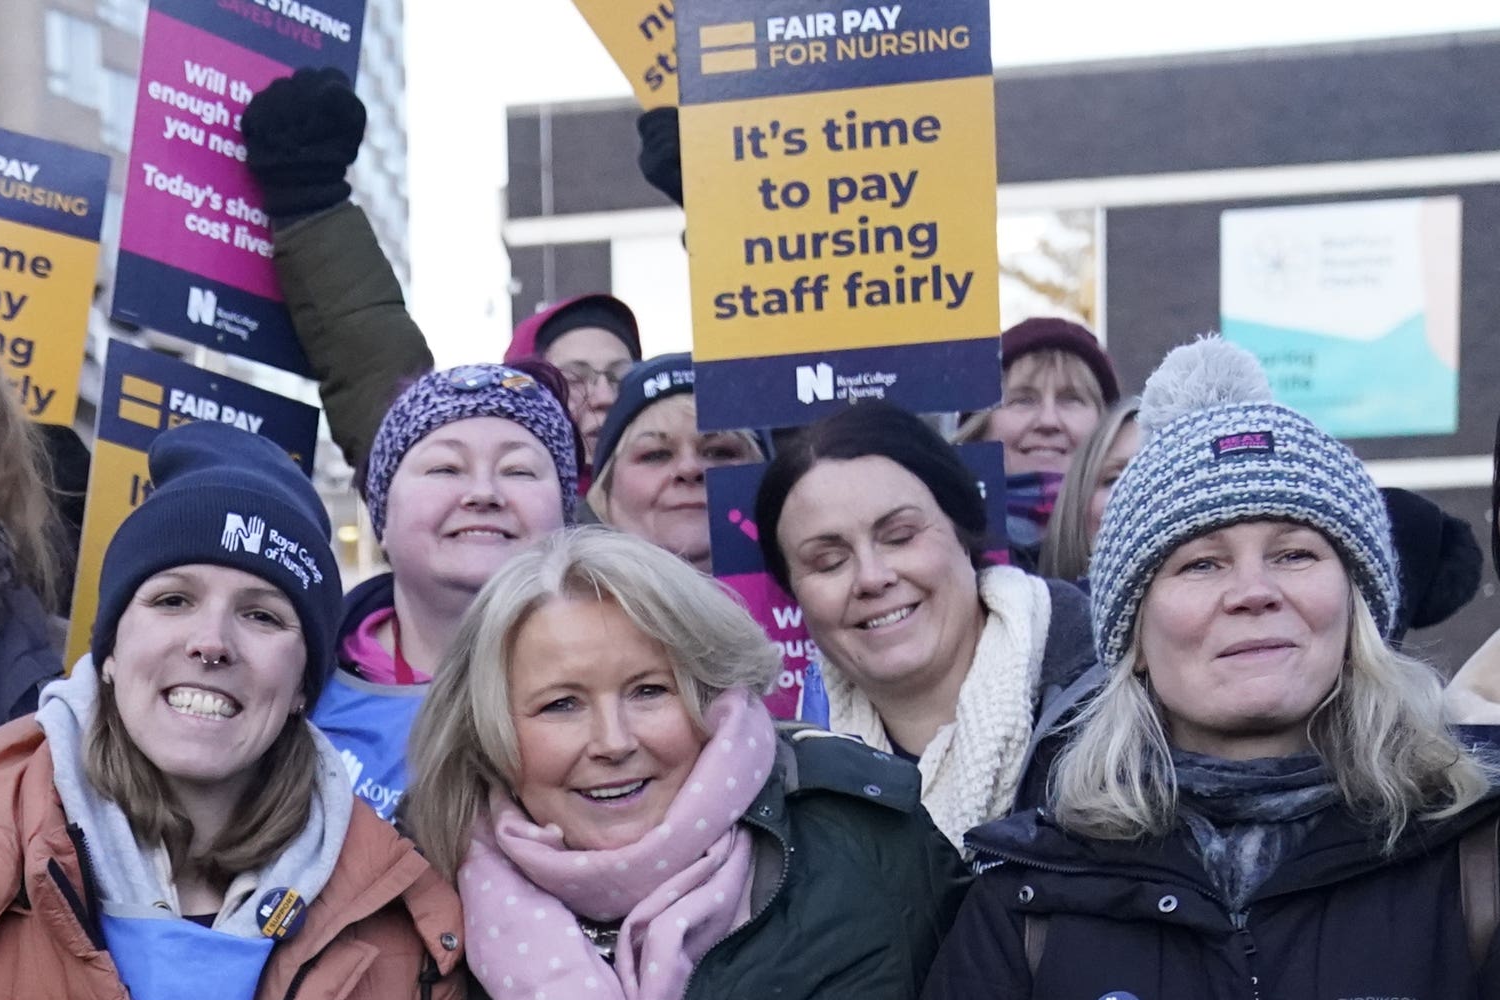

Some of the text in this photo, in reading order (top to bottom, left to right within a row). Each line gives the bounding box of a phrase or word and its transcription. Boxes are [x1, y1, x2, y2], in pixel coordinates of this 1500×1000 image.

[767, 4, 902, 42] FAIR PAY
[769, 25, 971, 69] FOR NURSING
[183, 60, 228, 96] Will
[148, 80, 230, 129] enough
[163, 116, 205, 146] you
[208, 131, 248, 162] nee
[732, 109, 942, 162] It's time
[143, 163, 223, 211] Today's
[757, 169, 919, 214] to pay
[185, 213, 231, 244] cost
[743, 215, 939, 266] nursing
[713, 263, 975, 320] staff fairly
[169, 387, 219, 422] FAIR
[220, 405, 264, 435] PAY
[264, 547, 279, 560] of
[268, 528, 300, 555] Royal
